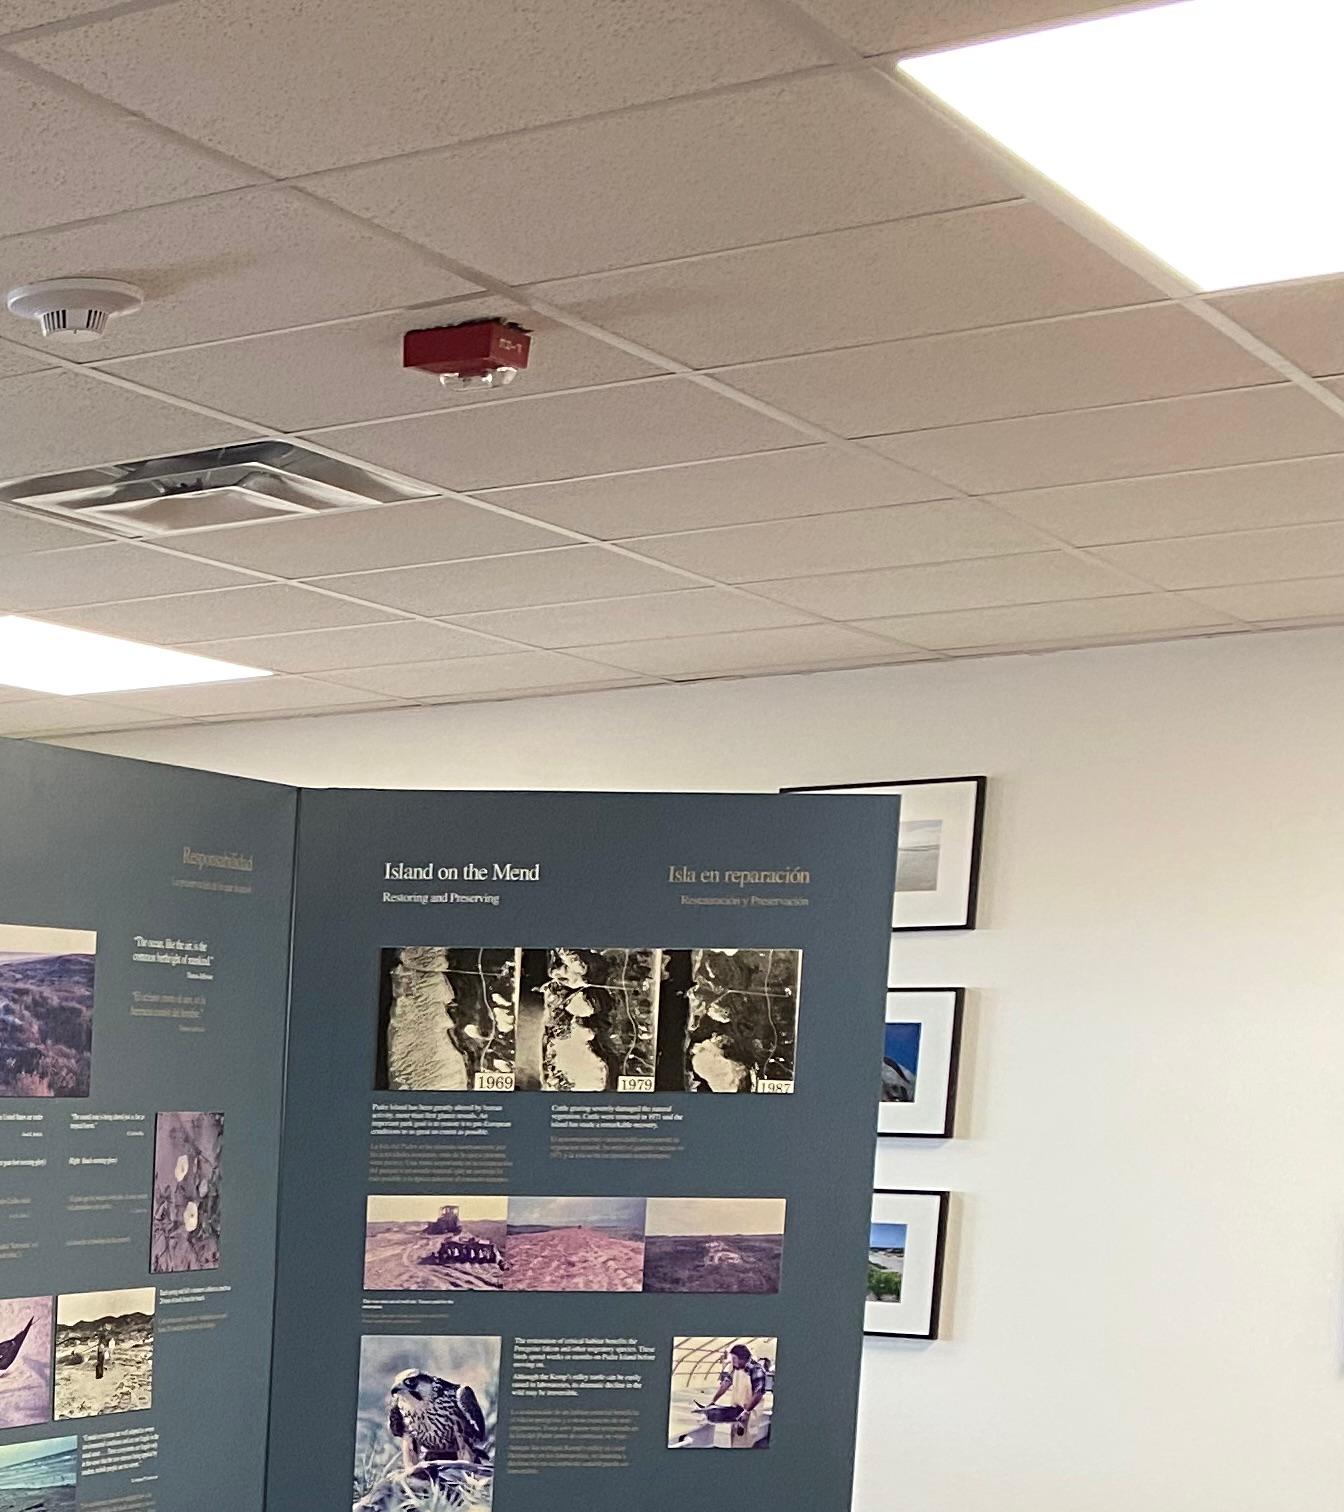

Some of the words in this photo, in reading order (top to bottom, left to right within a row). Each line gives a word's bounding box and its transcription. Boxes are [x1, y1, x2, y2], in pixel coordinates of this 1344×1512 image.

[385, 863, 433, 879] Island
[438, 868, 457, 879] on
[464, 864, 487, 880] the
[493, 864, 539, 880] Mend
[669, 866, 695, 882] Isla
[701, 871, 719, 882] en
[725, 867, 809, 886] reparación
[383, 892, 428, 904] Restoring
[430, 893, 448, 902] and
[450, 893, 499, 905] Preserving
[477, 1075, 514, 1089] 1969
[621, 1079, 653, 1091] 1979
[762, 1082, 791, 1093] 1987
